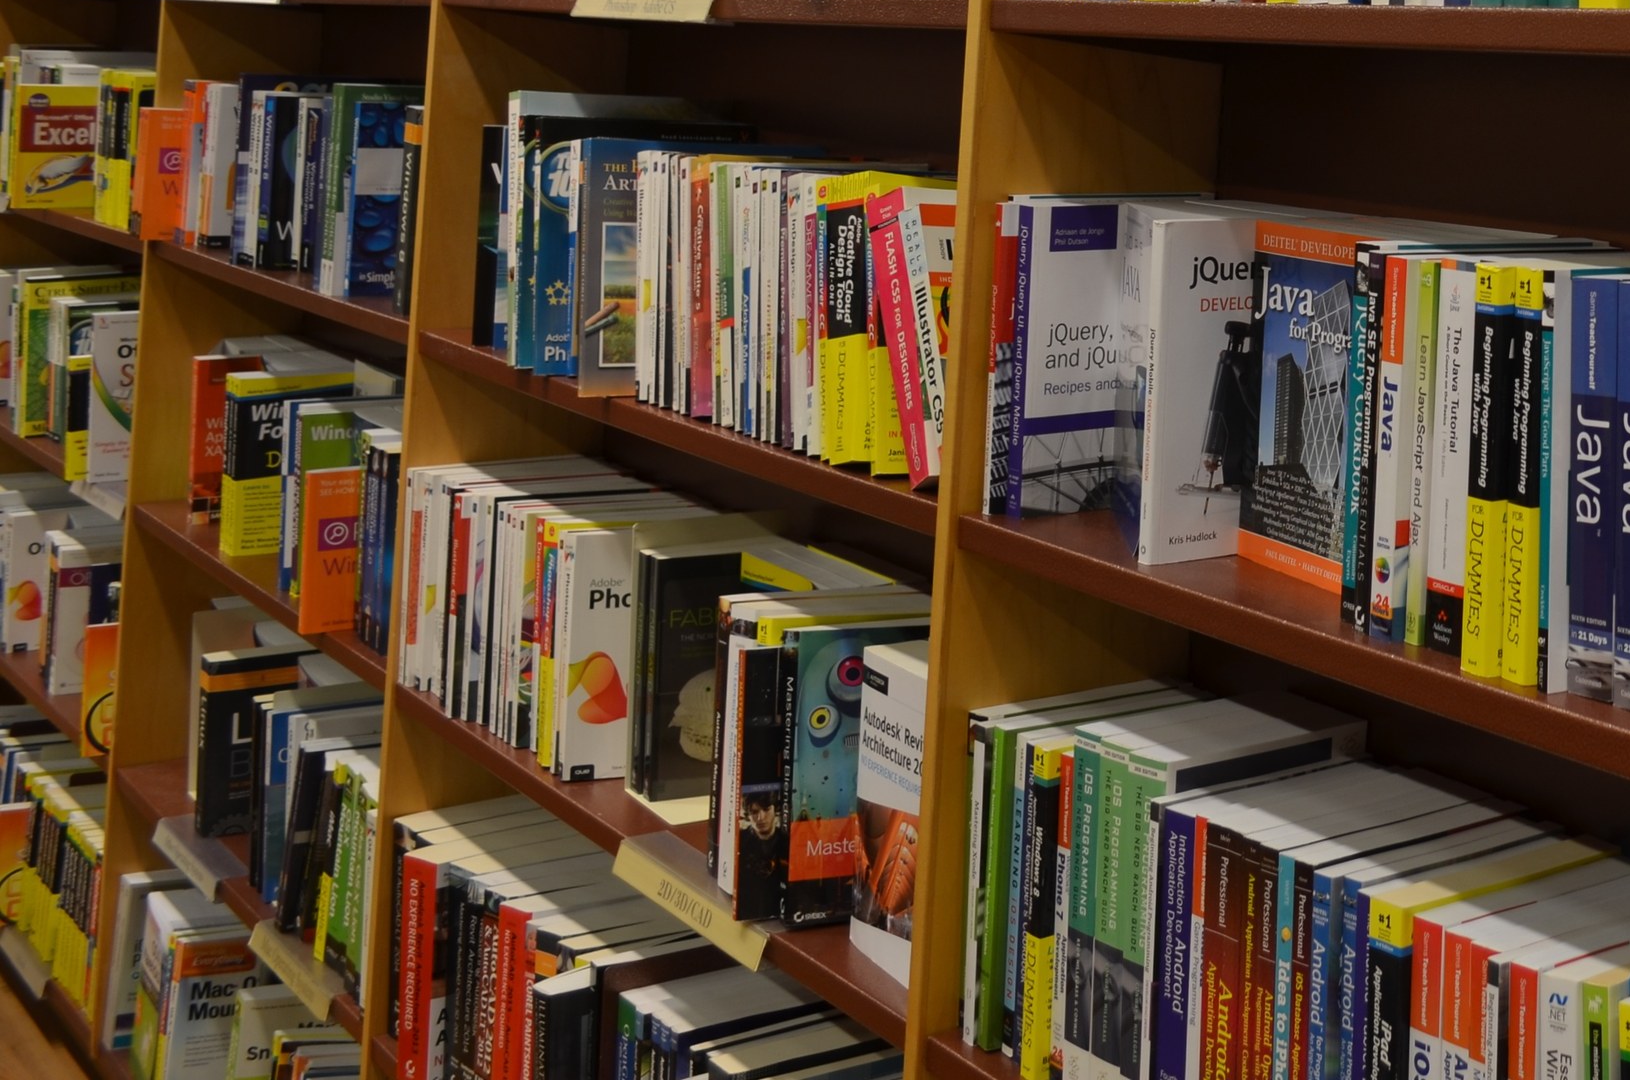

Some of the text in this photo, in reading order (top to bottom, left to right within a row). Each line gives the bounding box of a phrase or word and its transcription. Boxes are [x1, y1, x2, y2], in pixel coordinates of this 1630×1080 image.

[33, 123, 95, 145] Excel
[1256, 266, 1315, 319] Java
[885, 231, 897, 275] FLASH
[891, 278, 900, 304] CS5
[898, 331, 913, 410] DESIGNERS
[1049, 324, 1114, 348] jQuery,
[915, 286, 944, 433] Illustrator CS5
[1044, 381, 1092, 396] Recipes
[1576, 405, 1609, 529] Java
[1169, 531, 1218, 546] Kris Hadlock
[591, 578, 623, 588] Adobe
[1578, 630, 1607, 645] 21 Days
[864, 707, 900, 741] Autodesk
[782, 677, 796, 829] Mastering Blender
[863, 731, 910, 770] Architecture
[657, 880, 712, 929] 2D/3D/CAD
[1311, 938, 1323, 1027] Android
